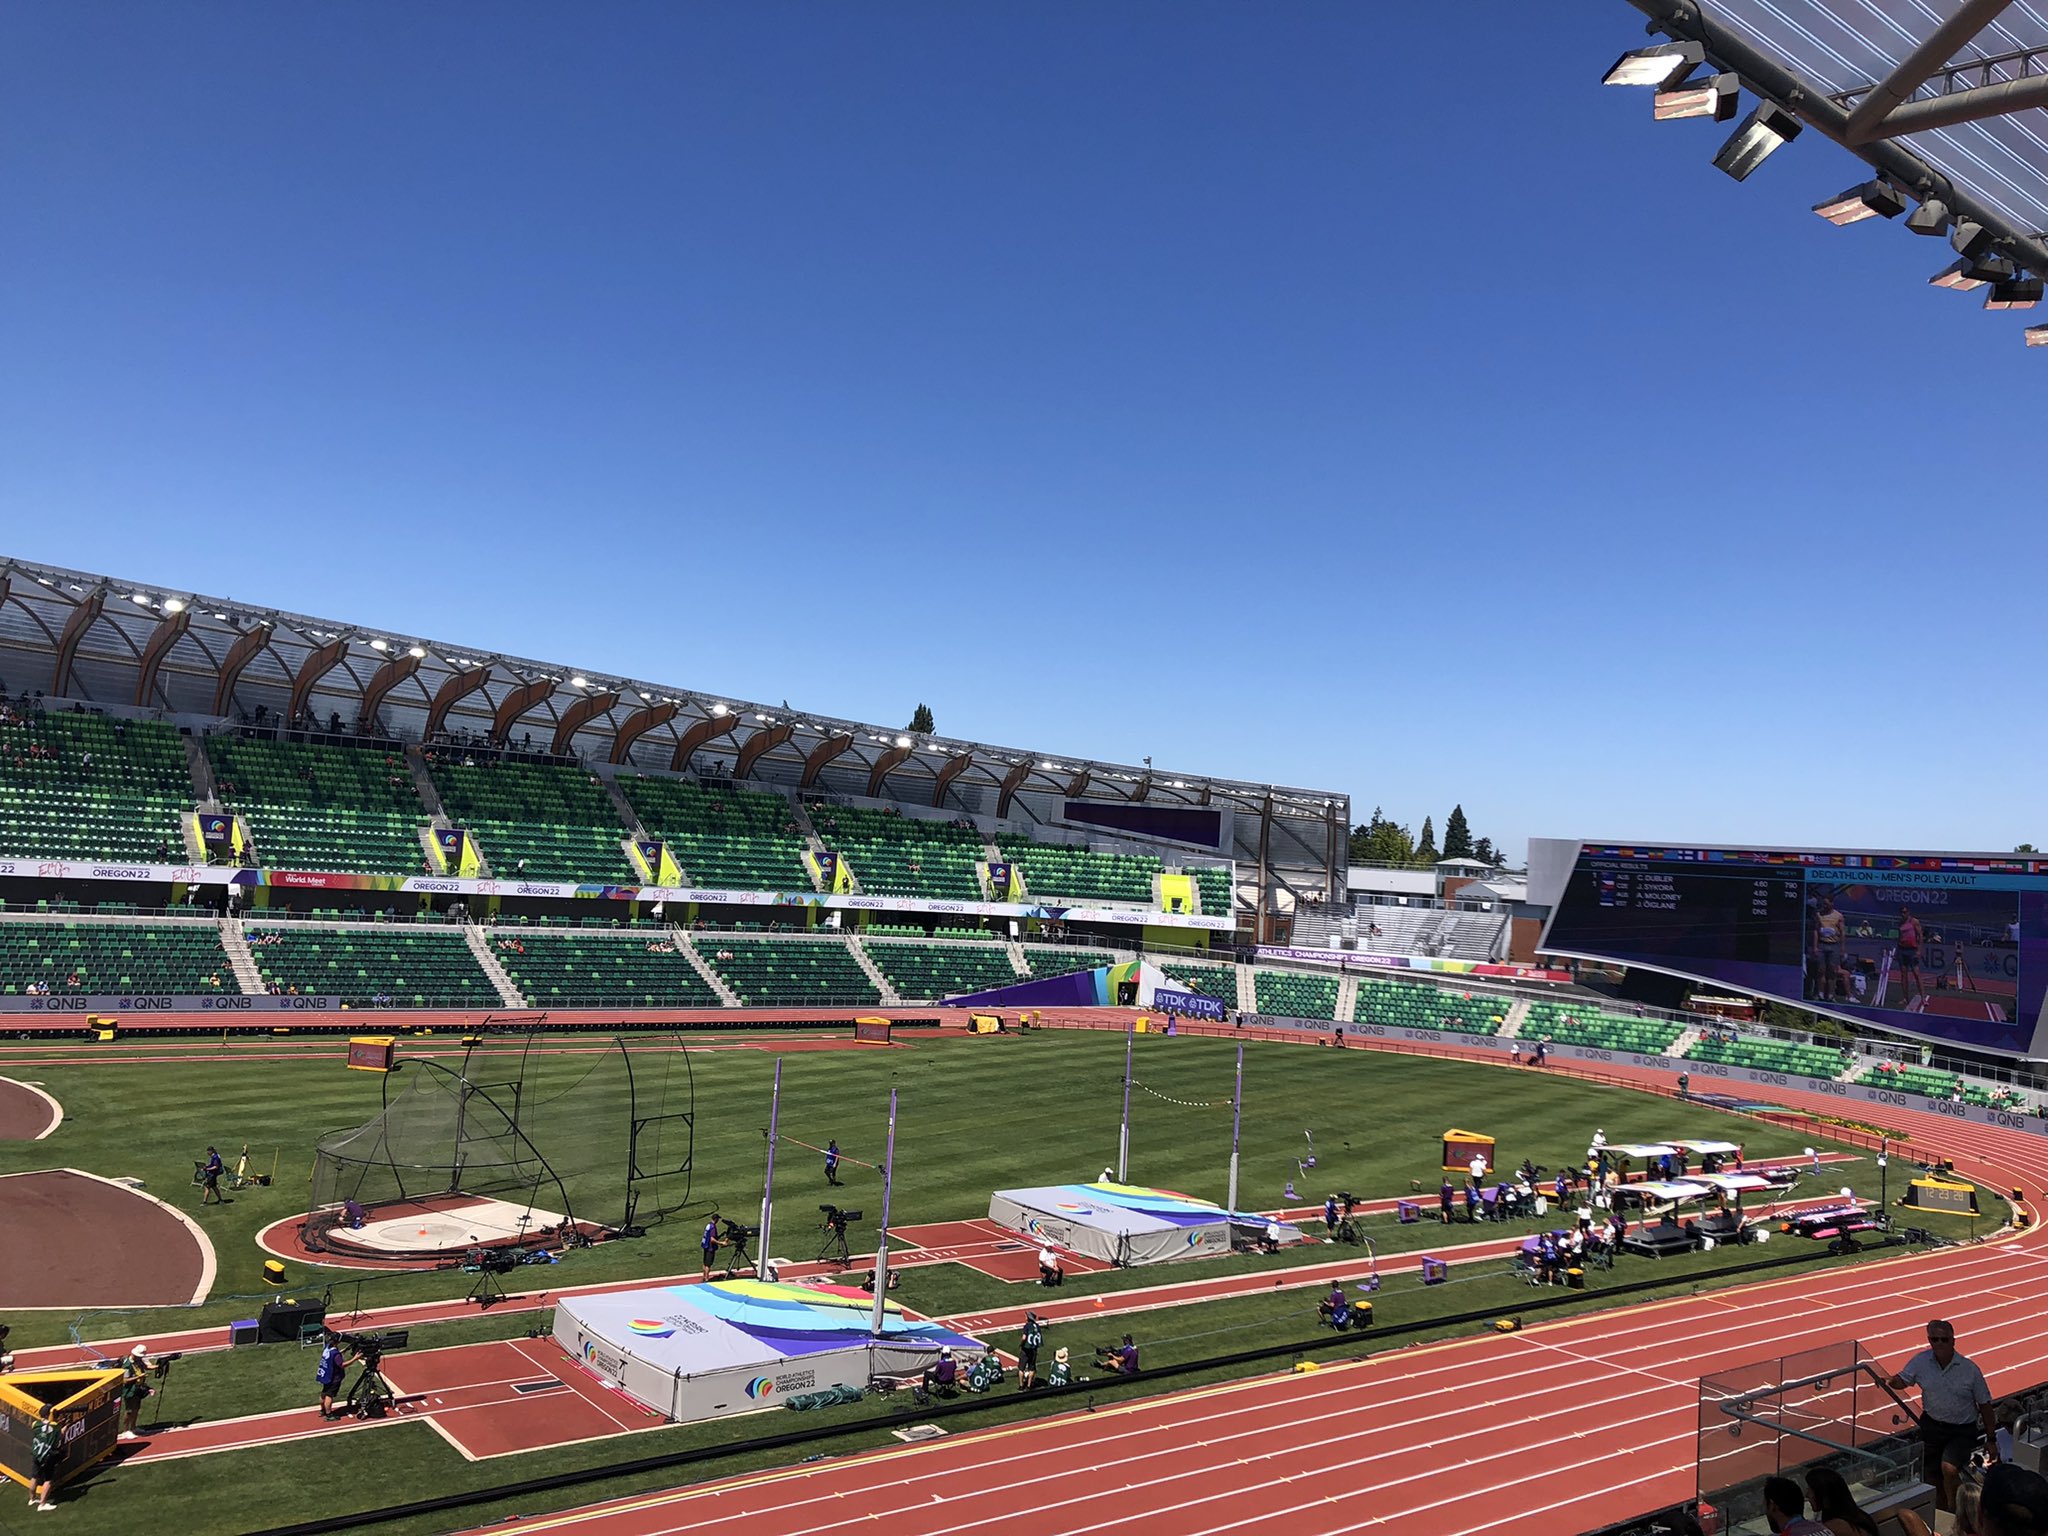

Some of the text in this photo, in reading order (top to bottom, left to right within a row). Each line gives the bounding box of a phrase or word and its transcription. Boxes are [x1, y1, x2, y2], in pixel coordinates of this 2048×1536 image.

[307, 877, 326, 885] Meet
[1812, 870, 1873, 881] DECATHLON
[1881, 873, 1912, 882] MEN'S
[1914, 875, 1939, 884] POLE
[1943, 876, 1977, 885] VAULT
[1644, 892, 1682, 901] MOLONEY
[1752, 898, 1768, 906] DNS
[1752, 908, 1767, 916] DNS
[1257, 948, 1293, 957] ATHLETICS
[1295, 951, 1348, 961] CHAMPIONSHIPS
[46, 998, 87, 1010] QNB
[134, 997, 172, 1010] QNB
[215, 997, 251, 1009] QNB
[293, 997, 327, 1009] QNB
[1163, 993, 1221, 1013] TDK TDK
[1249, 1015, 1275, 1026] QNB
[1304, 1019, 1330, 1031] QNB
[1358, 1024, 1385, 1036] QNB
[1415, 1030, 1441, 1042] QNB
[1470, 1036, 1497, 1048] QNB
[1585, 1049, 1612, 1061] QNB
[1643, 1055, 1671, 1069] QNB
[1700, 1063, 1729, 1077] QNB
[1759, 1072, 1788, 1086] QNB
[1818, 1081, 1847, 1096] QNB
[1878, 1090, 1907, 1106] QNB
[1938, 1102, 1966, 1117] QNB
[1997, 1112, 2025, 1129] QNB
[776, 1369, 815, 1381] WORLD ATHLETICS
[776, 1374, 815, 1386] CHAMPIONSHIPS
